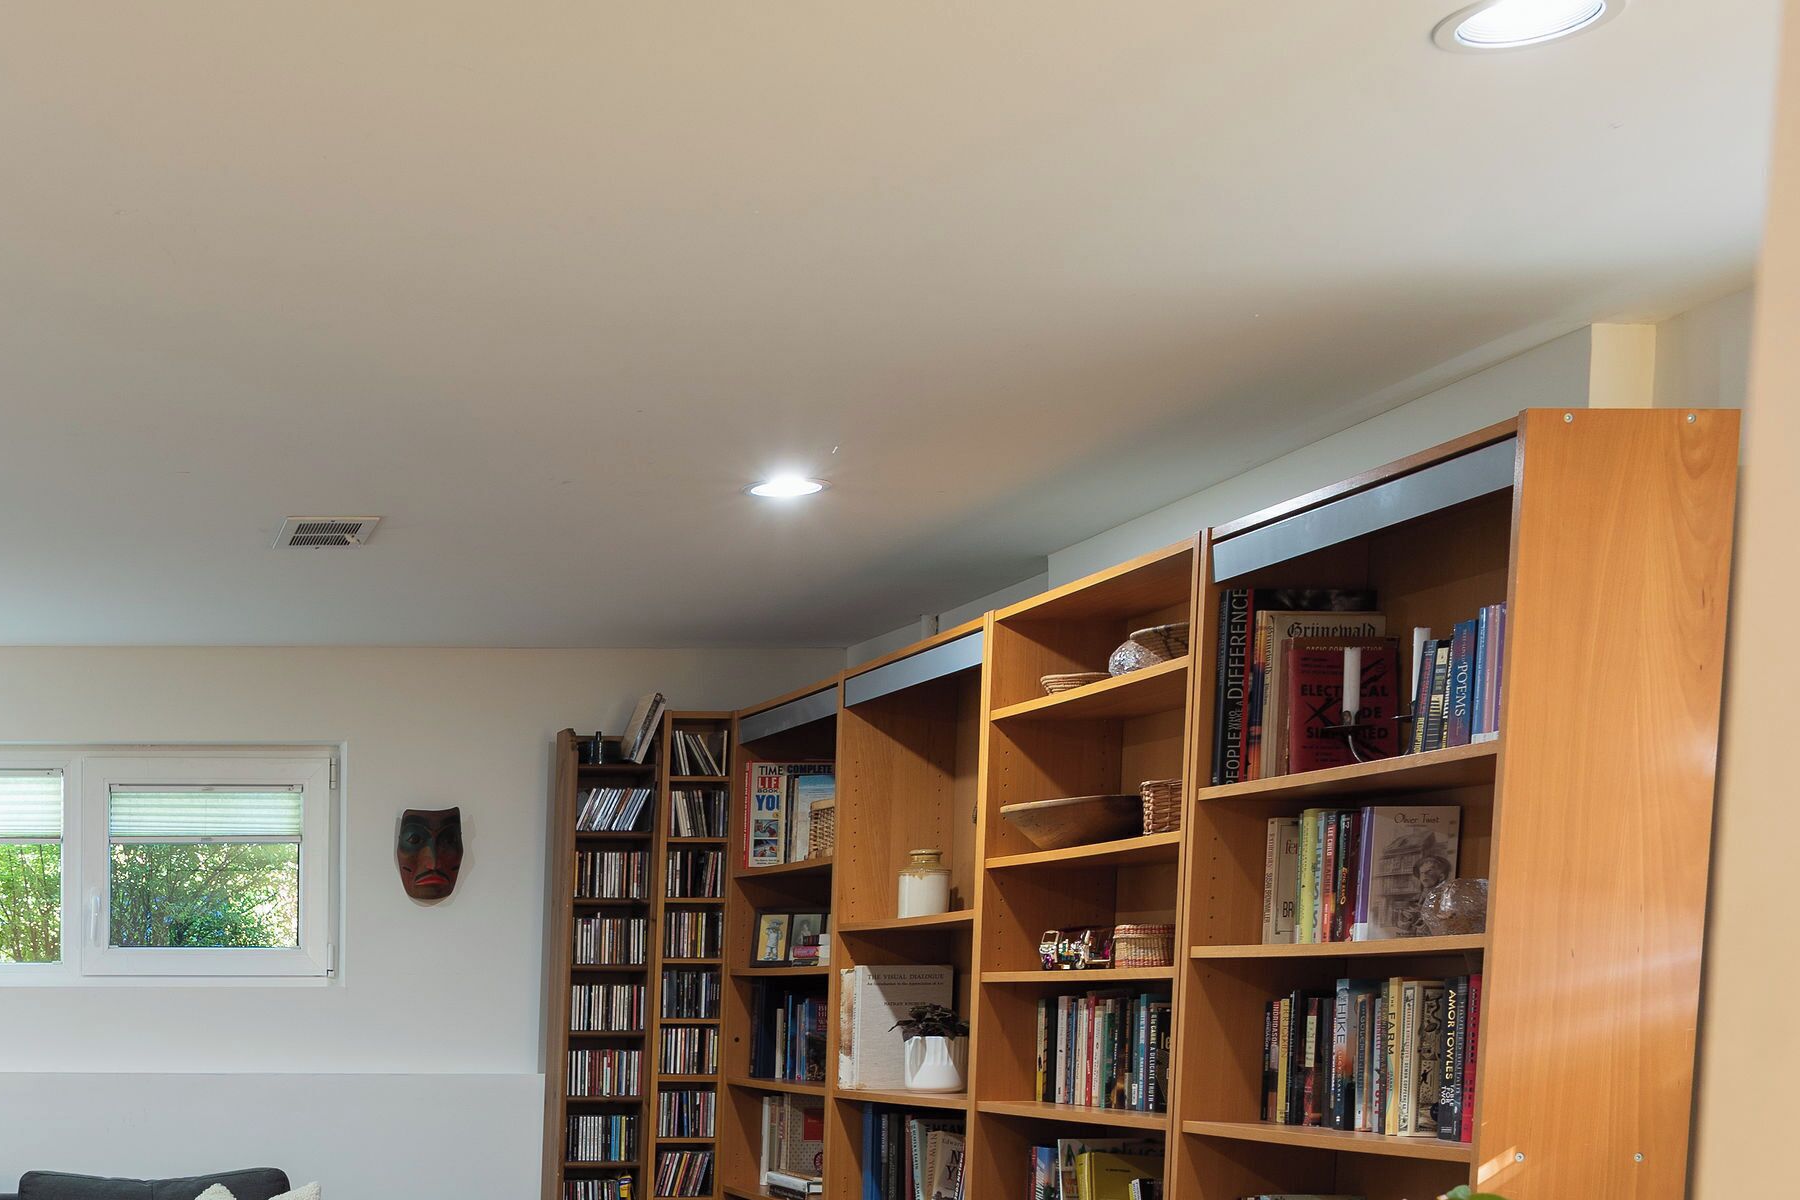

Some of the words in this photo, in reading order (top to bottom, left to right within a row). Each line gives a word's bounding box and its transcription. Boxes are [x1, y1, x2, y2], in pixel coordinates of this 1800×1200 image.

[1227, 589, 1248, 699] DIFFERENCE
[1454, 661, 1469, 718] POEMS
[1337, 1003, 1347, 1044] HIKE
[1447, 989, 1456, 1027] AMOR
[1445, 1031, 1455, 1080] TOWLES
